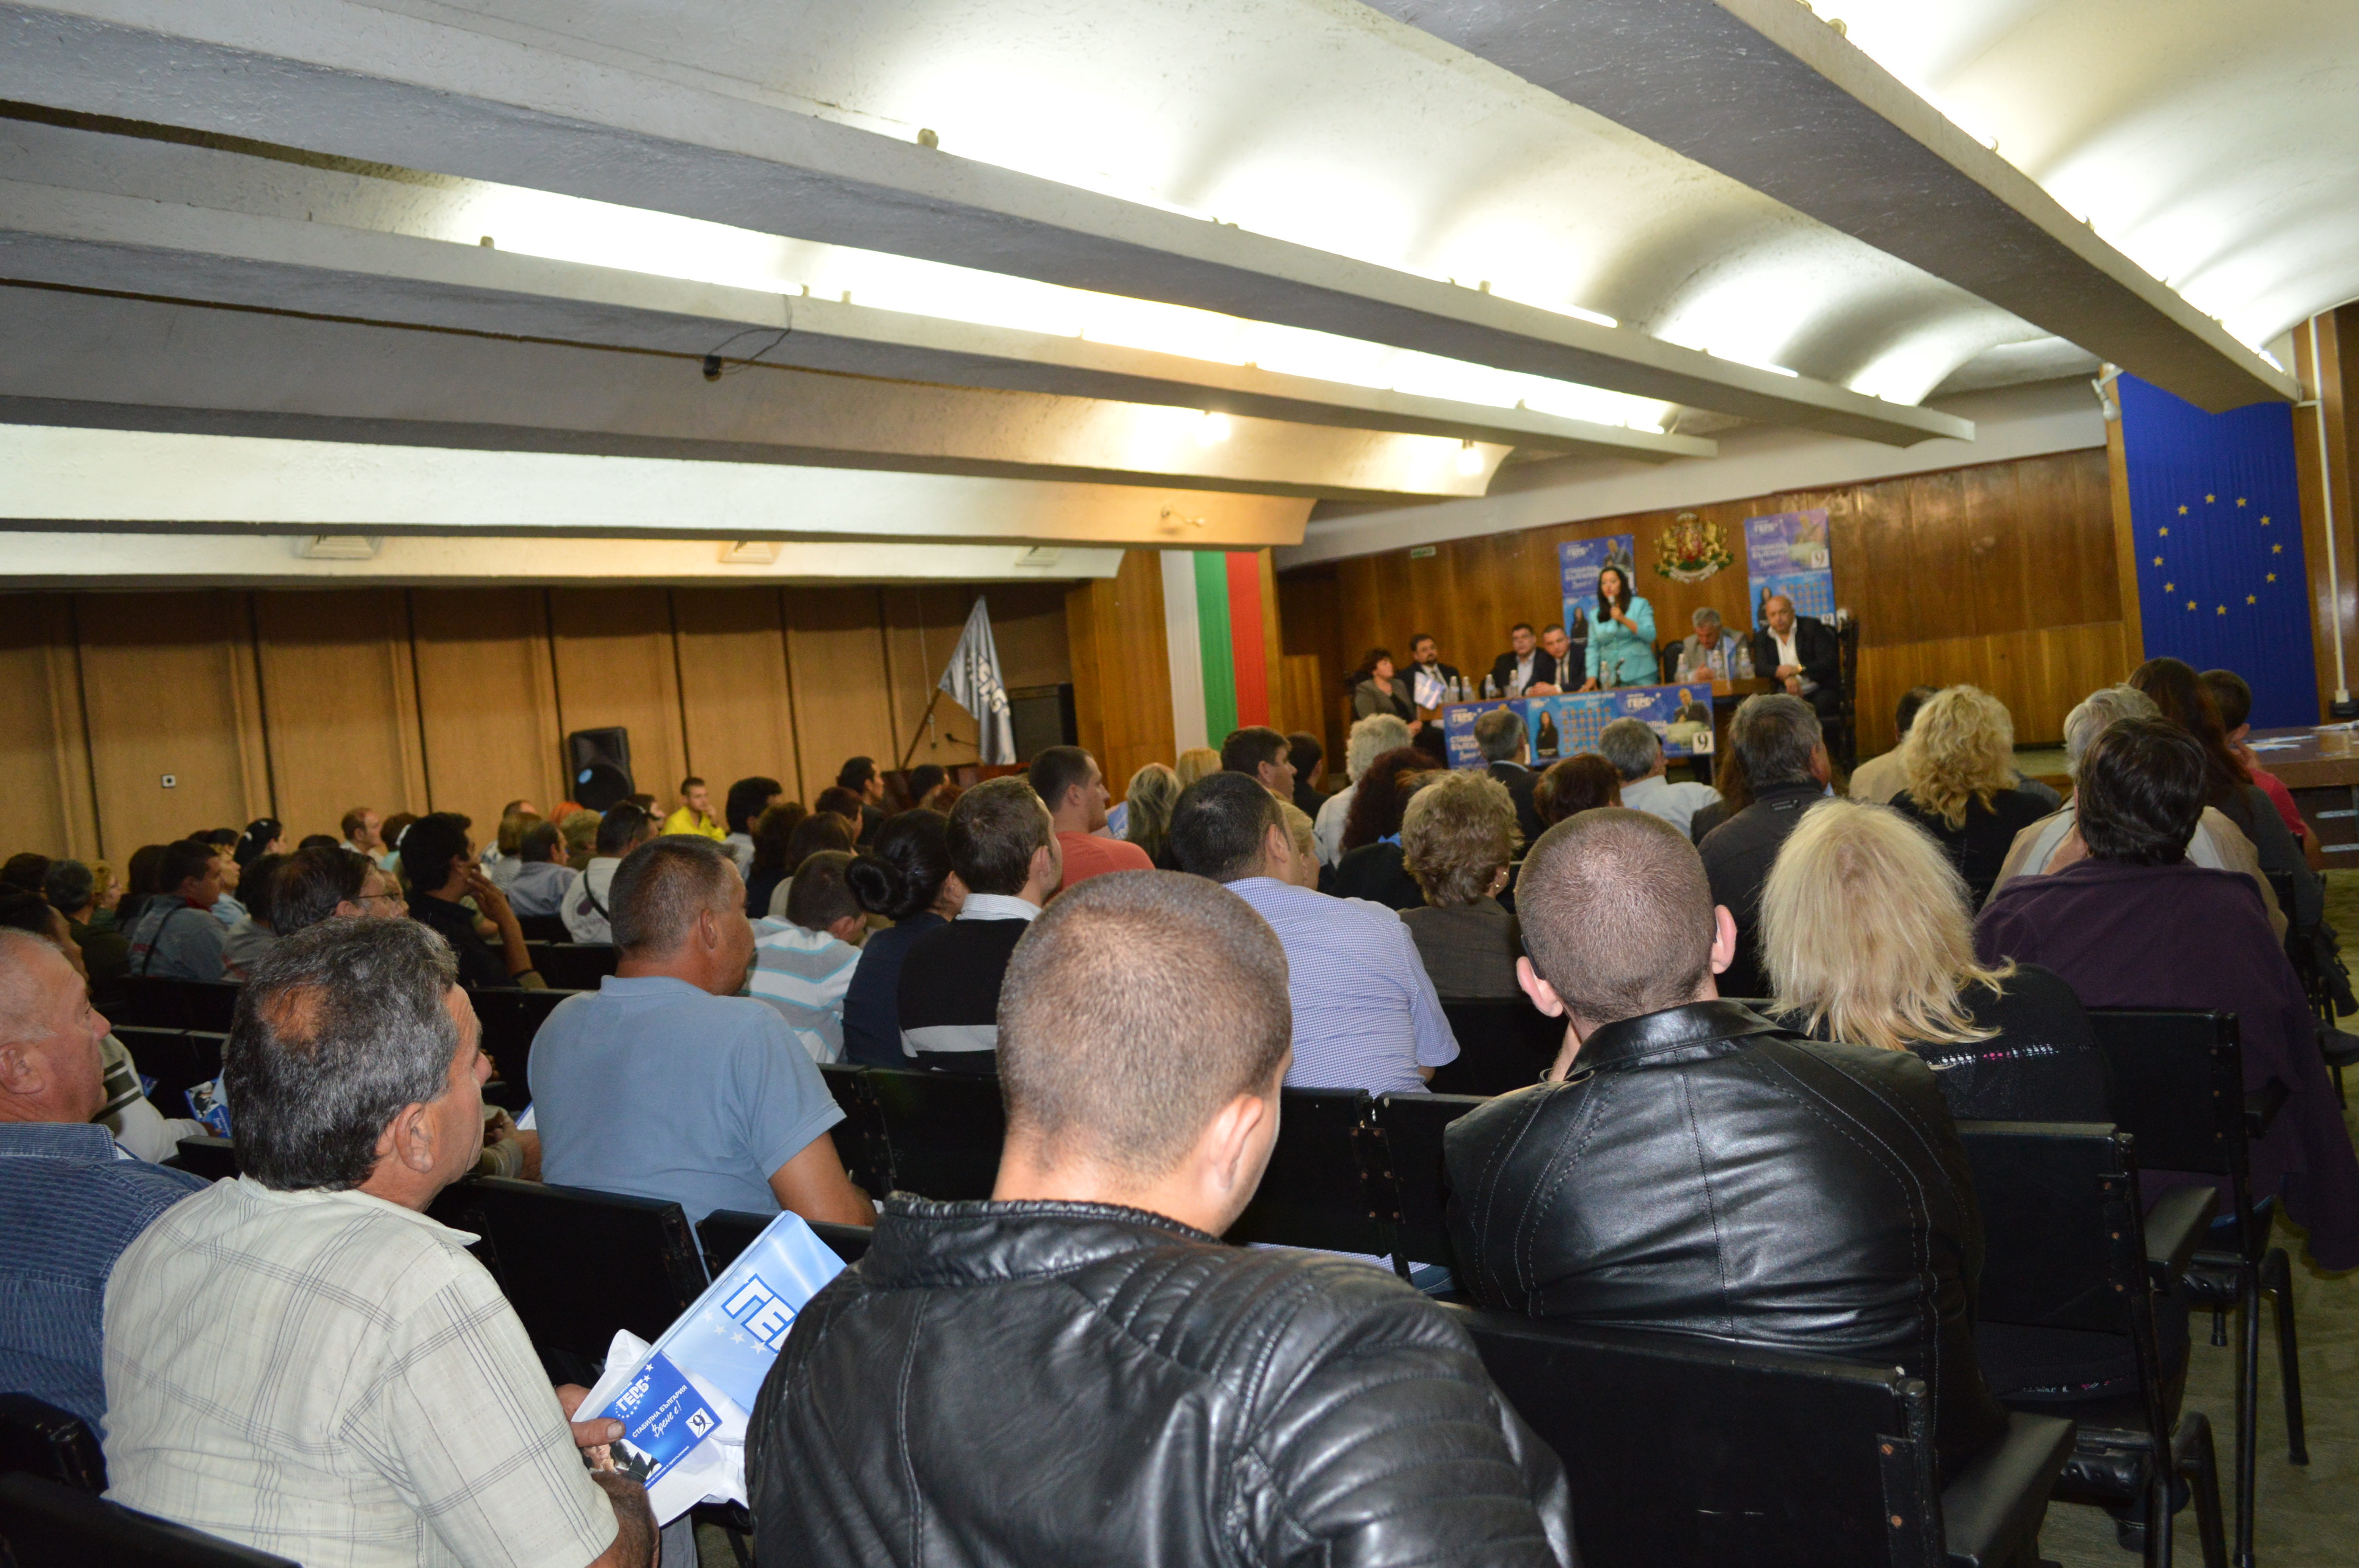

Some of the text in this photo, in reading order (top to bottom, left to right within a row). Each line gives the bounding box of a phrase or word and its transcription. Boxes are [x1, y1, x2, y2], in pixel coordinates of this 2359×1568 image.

[1698, 733, 1708, 750] 9
[615, 1378, 649, 1412] ГЕРБ
[632, 1411, 661, 1438] СТАБИЛНА
[659, 1385, 688, 1413] БЪЛГАРИЯ
[651, 1411, 674, 1438] Време
[693, 1414, 706, 1433] 9
